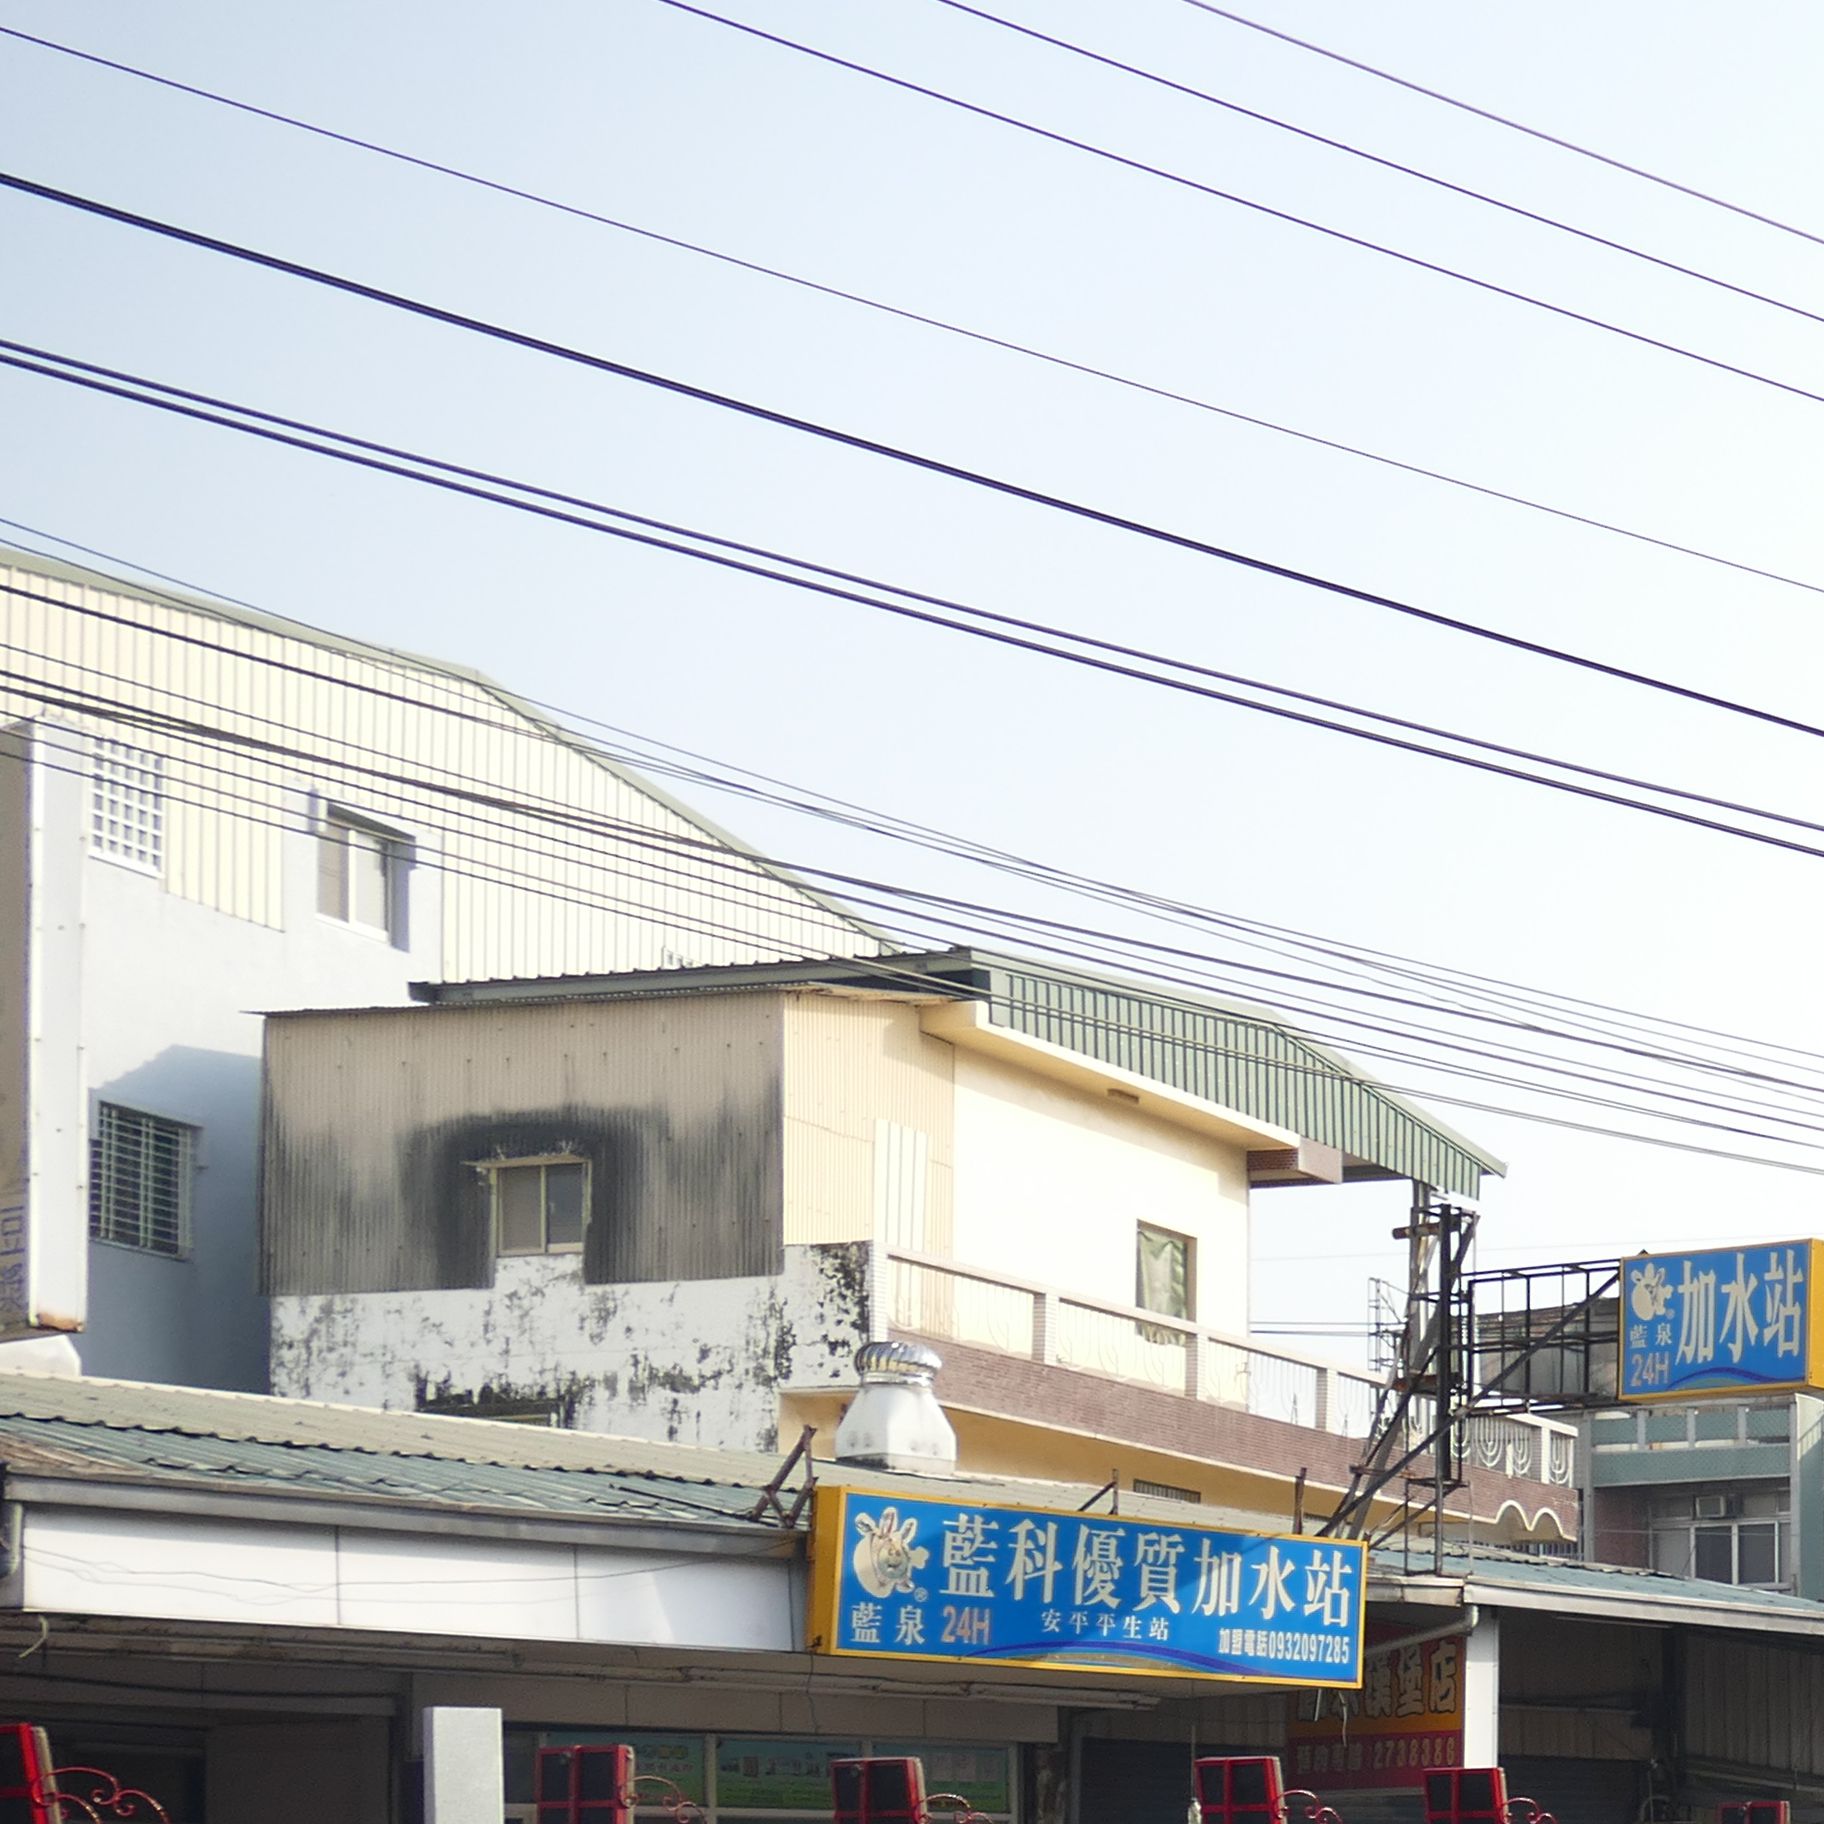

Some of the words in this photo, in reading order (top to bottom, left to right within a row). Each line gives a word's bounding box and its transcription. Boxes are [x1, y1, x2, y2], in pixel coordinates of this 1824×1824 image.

[1675, 1249, 1804, 1366] 加水站
[1630, 1352, 1670, 1387] 24H
[938, 1512, 1355, 1628] 藍科優質加水站
[851, 1601, 926, 1646] 藍泉
[941, 1606, 990, 1646] 24H
